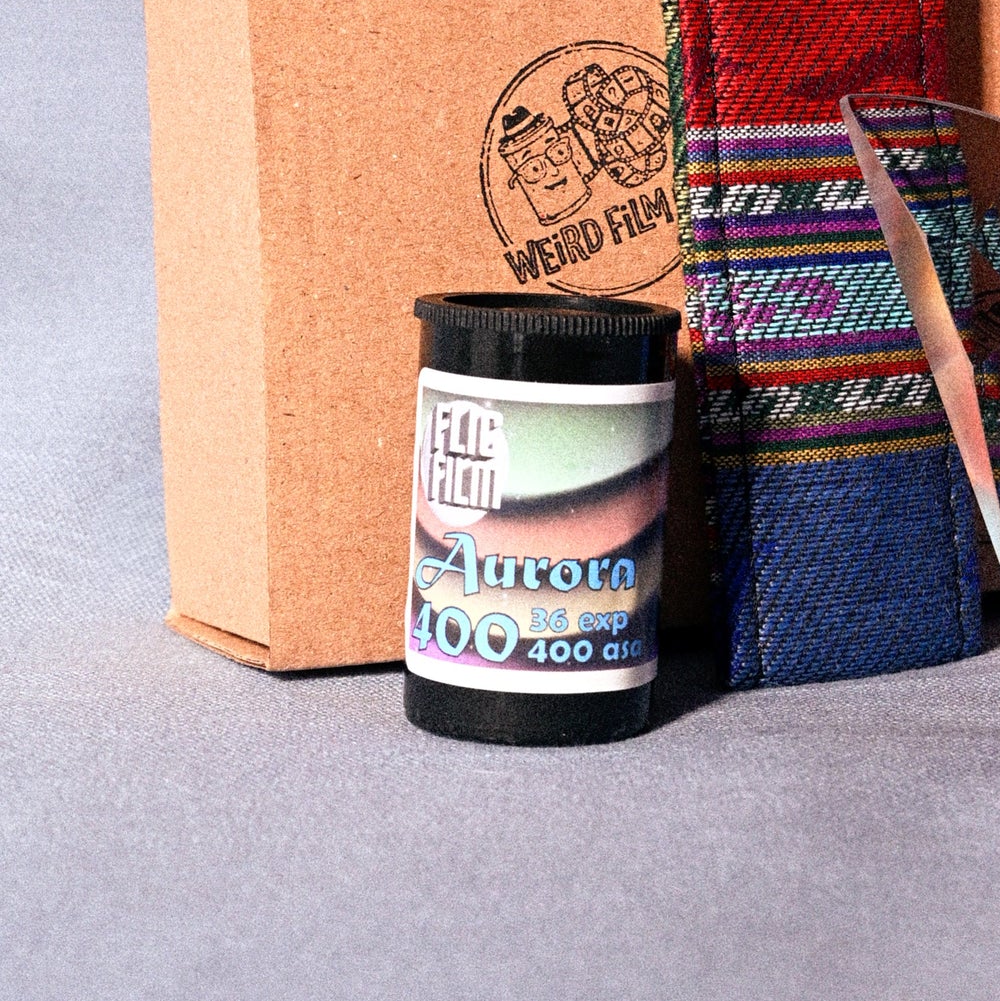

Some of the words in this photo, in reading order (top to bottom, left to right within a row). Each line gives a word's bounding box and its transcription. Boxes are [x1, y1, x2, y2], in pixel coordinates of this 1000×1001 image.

[415, 531, 636, 596] Aurora
[412, 601, 520, 663] 400
[529, 608, 569, 633] 36
[578, 610, 629, 636] exp
[528, 639, 593, 663] 400
[602, 639, 642, 662] asa
